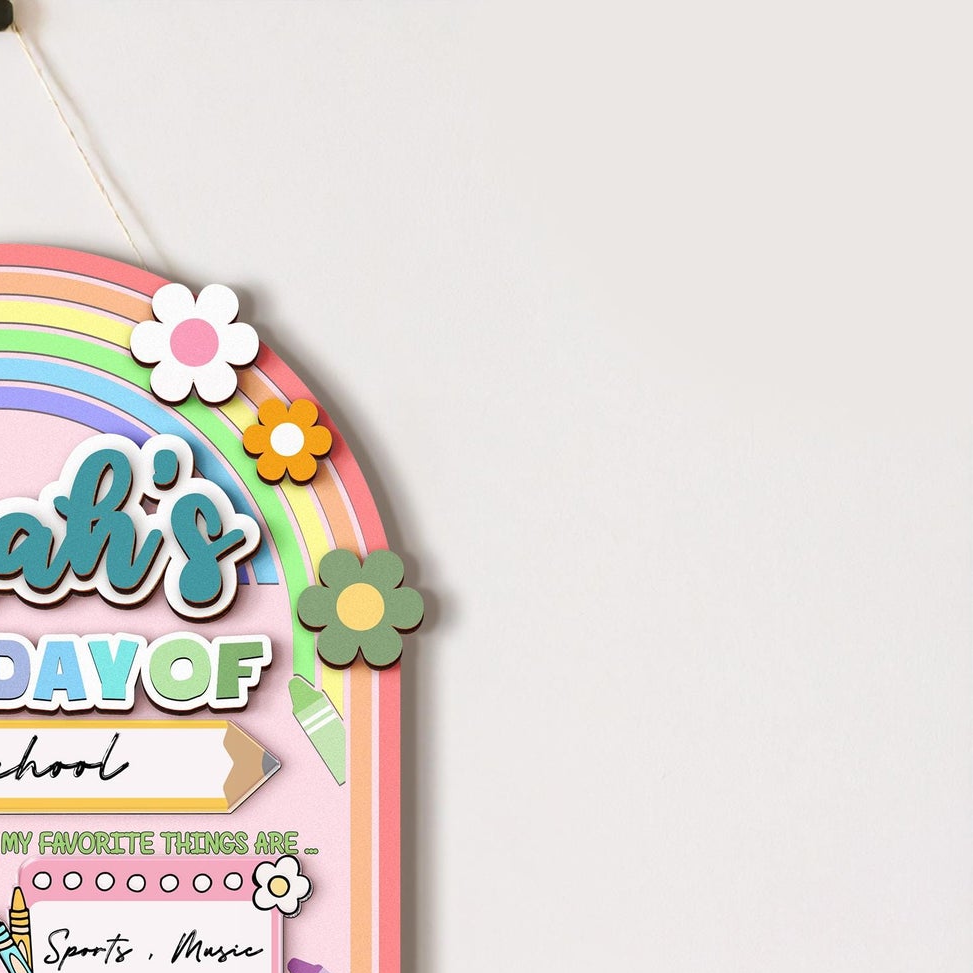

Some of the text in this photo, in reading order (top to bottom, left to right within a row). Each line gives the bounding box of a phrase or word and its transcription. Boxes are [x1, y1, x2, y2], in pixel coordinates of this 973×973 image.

[149, 638, 264, 702] OF
[1, 831, 33, 855] MY
[38, 831, 155, 855] FAVORITE
[160, 831, 249, 855] THINGS
[254, 831, 299, 855] ARE
[43, 928, 133, 971] Sports
[171, 929, 264, 964] Music
